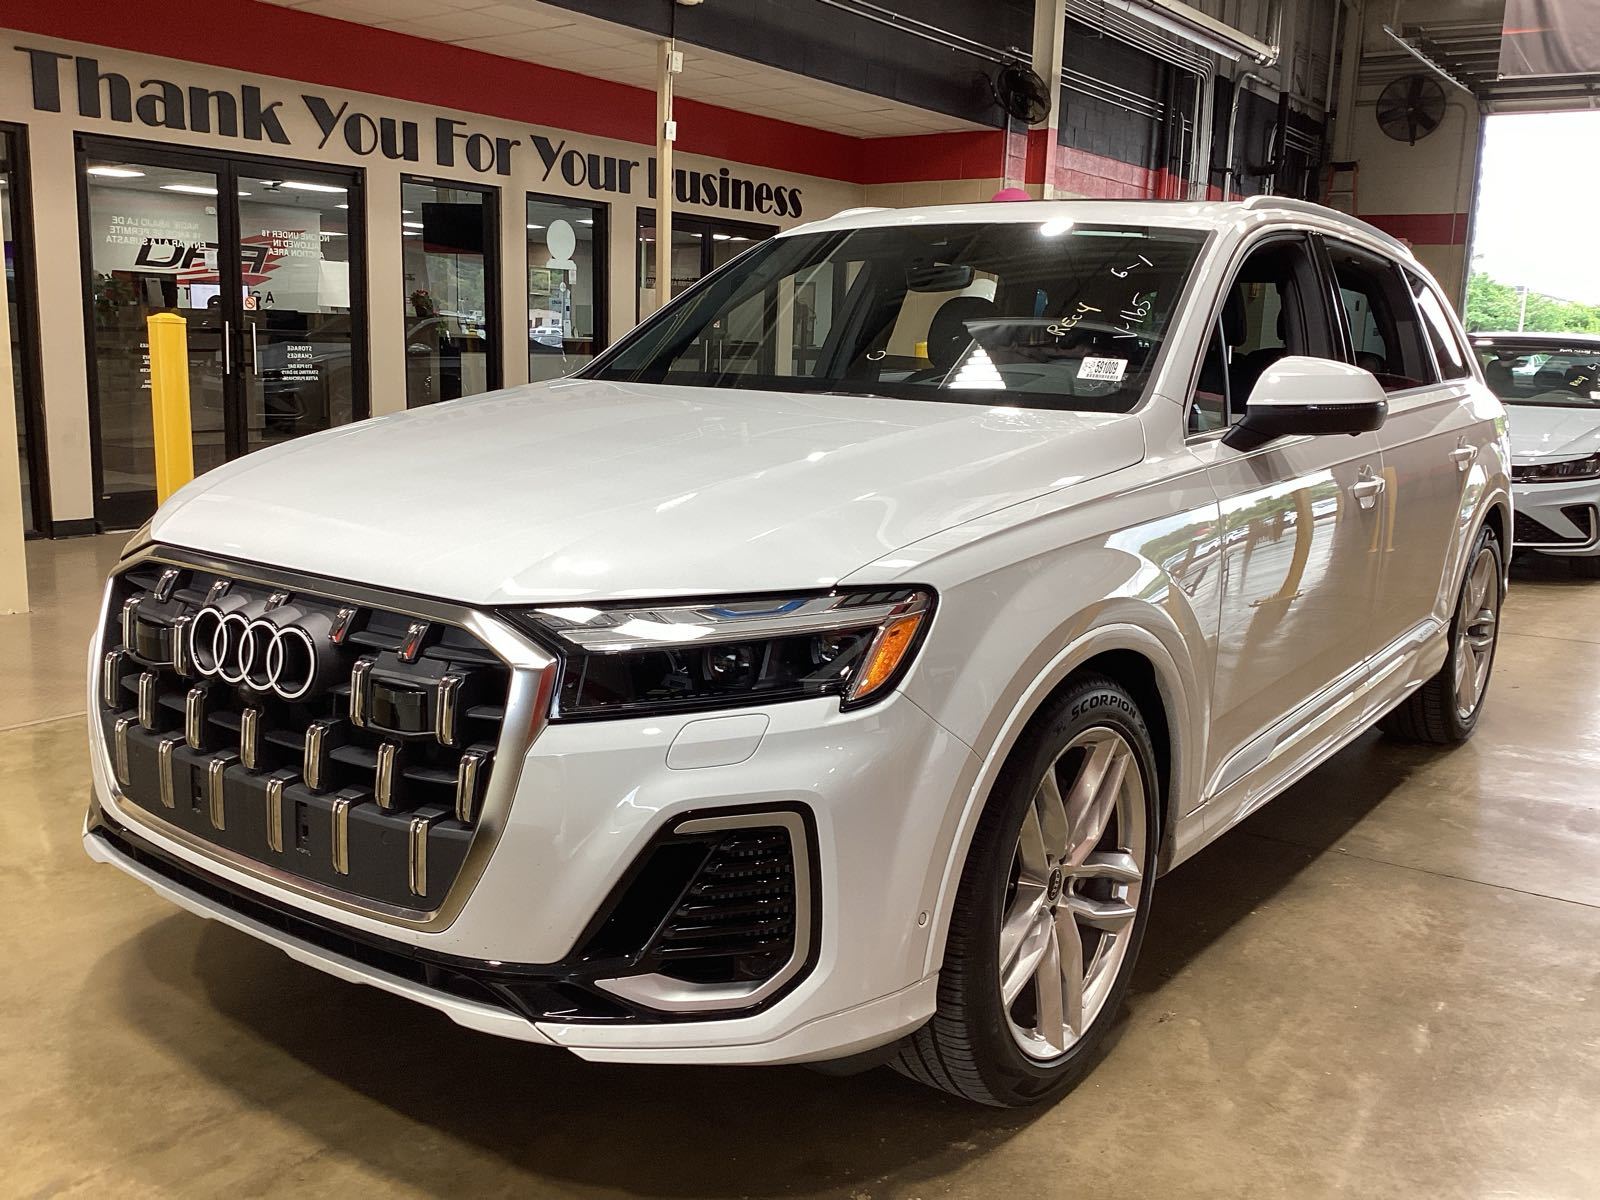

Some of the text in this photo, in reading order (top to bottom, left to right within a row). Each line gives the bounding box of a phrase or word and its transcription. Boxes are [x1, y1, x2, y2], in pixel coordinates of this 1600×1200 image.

[13, 45, 292, 146] Thank
[301, 94, 419, 162] You
[436, 117, 522, 177] For
[529, 134, 640, 195] Your
[1071, 694, 1137, 721] SCORPION
